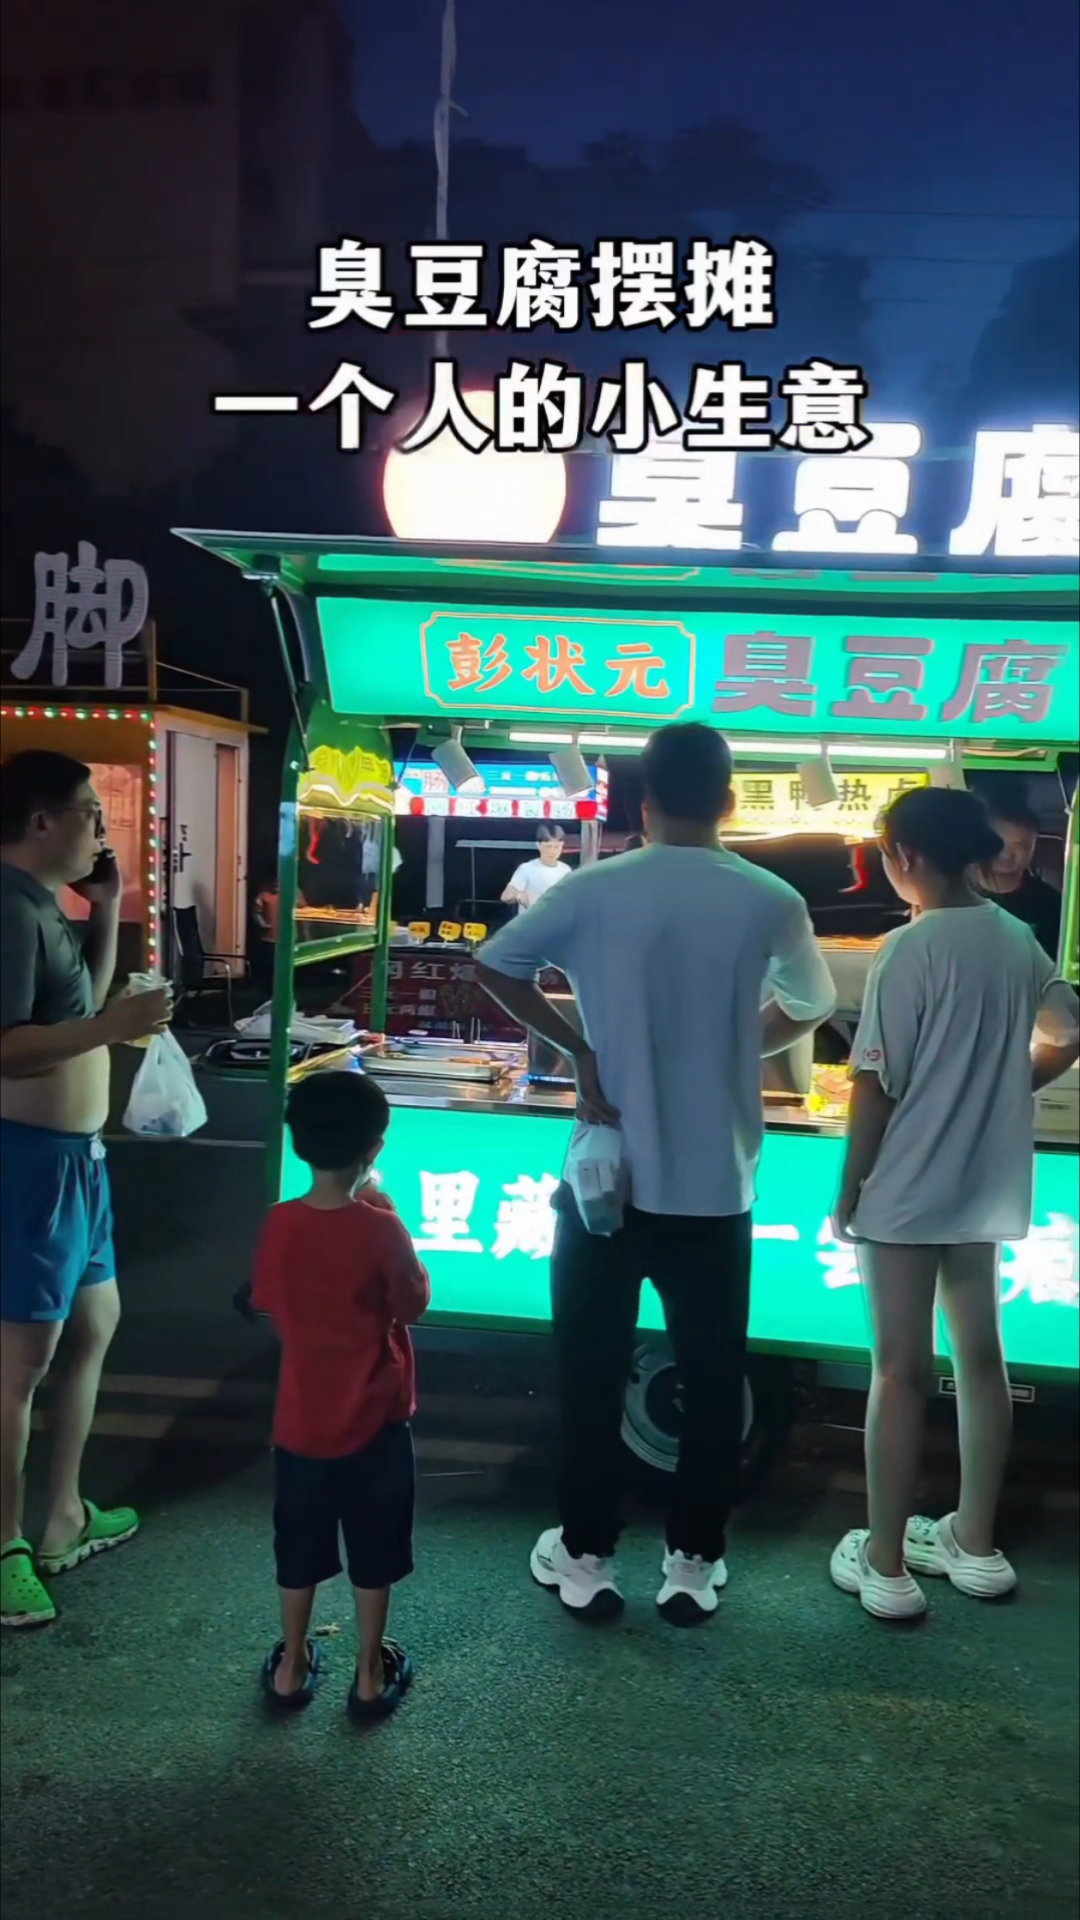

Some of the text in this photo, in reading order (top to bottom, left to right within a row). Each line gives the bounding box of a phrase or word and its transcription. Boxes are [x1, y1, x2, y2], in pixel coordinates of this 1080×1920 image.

[596, 423, 1079, 556] 臭豆腐
[10, 540, 149, 690] 脚
[446, 631, 1068, 724] 彭状元 臭豆腐
